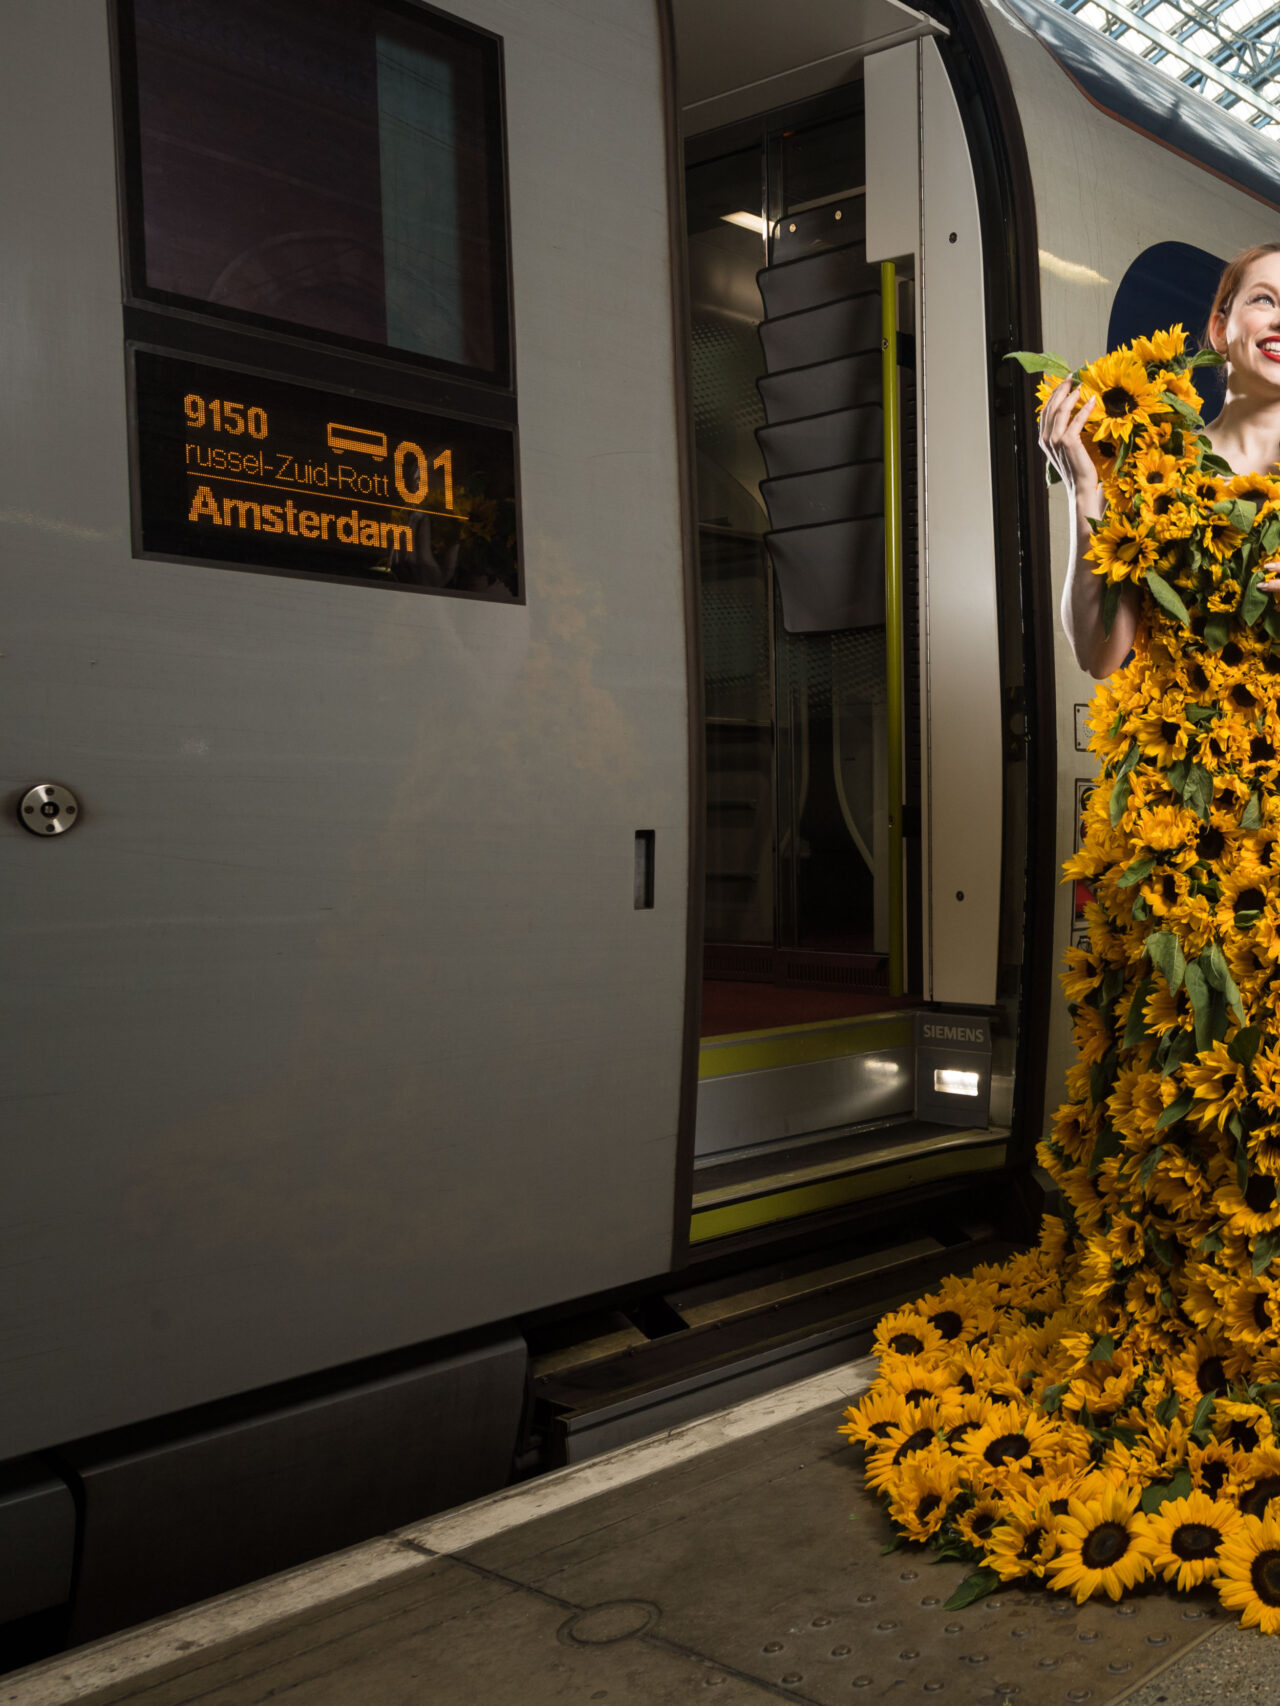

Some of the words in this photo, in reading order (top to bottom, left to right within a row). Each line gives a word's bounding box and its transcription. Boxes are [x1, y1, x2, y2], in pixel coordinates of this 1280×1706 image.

[183, 393, 269, 440] 9150
[185, 442, 390, 498] russel-Zuid-Rott
[393, 440, 454, 510] 01
[188, 485, 415, 552] Amsterdam
[923, 1024, 985, 1043] SIEMENS
